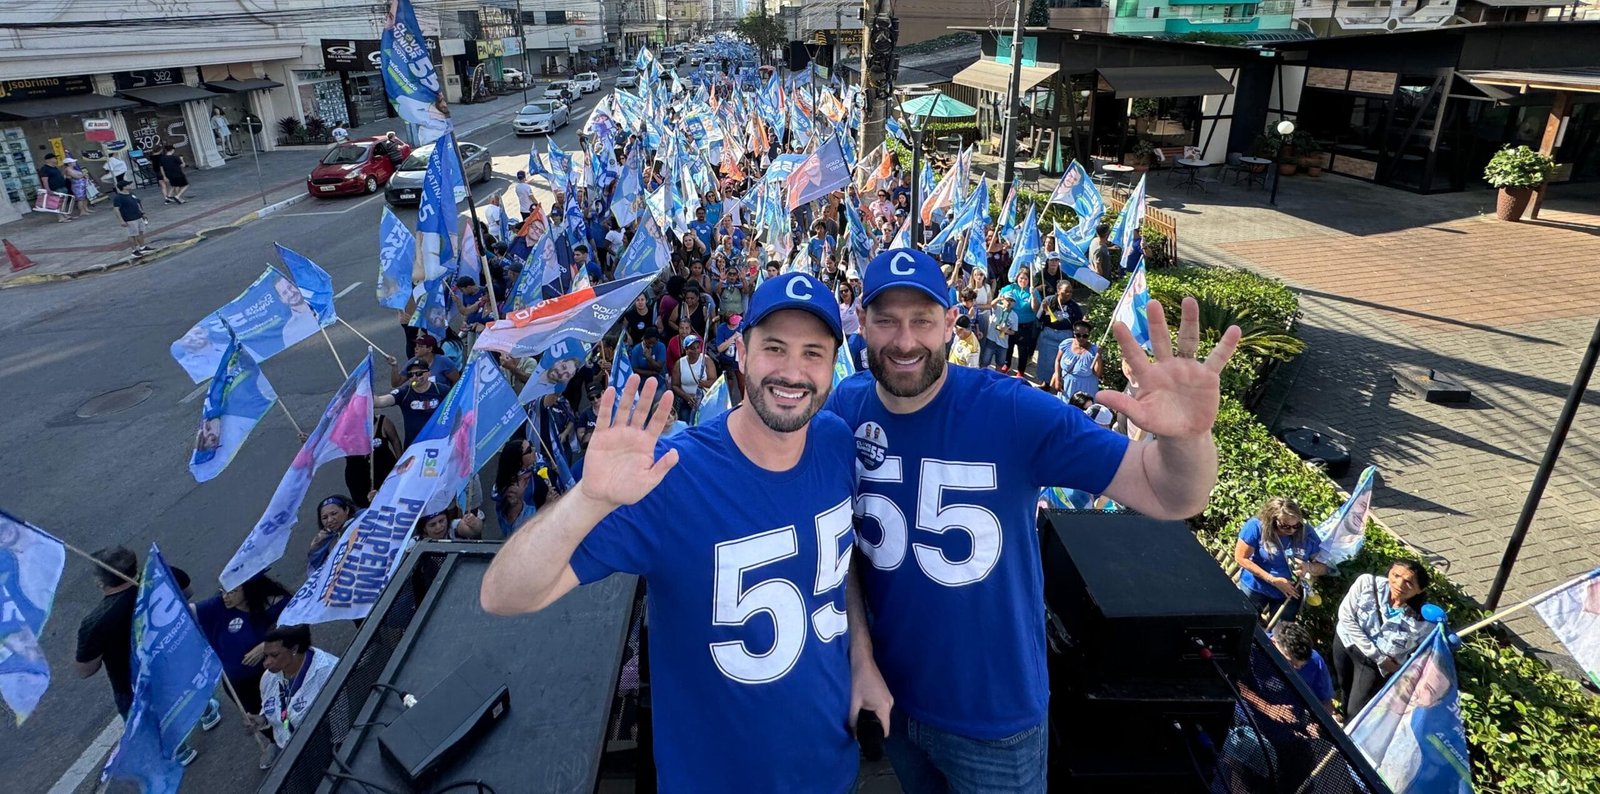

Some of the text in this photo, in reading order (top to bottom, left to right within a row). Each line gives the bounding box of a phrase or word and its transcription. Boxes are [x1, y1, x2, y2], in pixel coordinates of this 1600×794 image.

[785, 275, 813, 301] C
[889, 251, 916, 276] C
[869, 445, 885, 462] 55
[854, 455, 1003, 587] 55
[352, 505, 397, 604] ITAPEMA
[709, 495, 853, 685] 55
